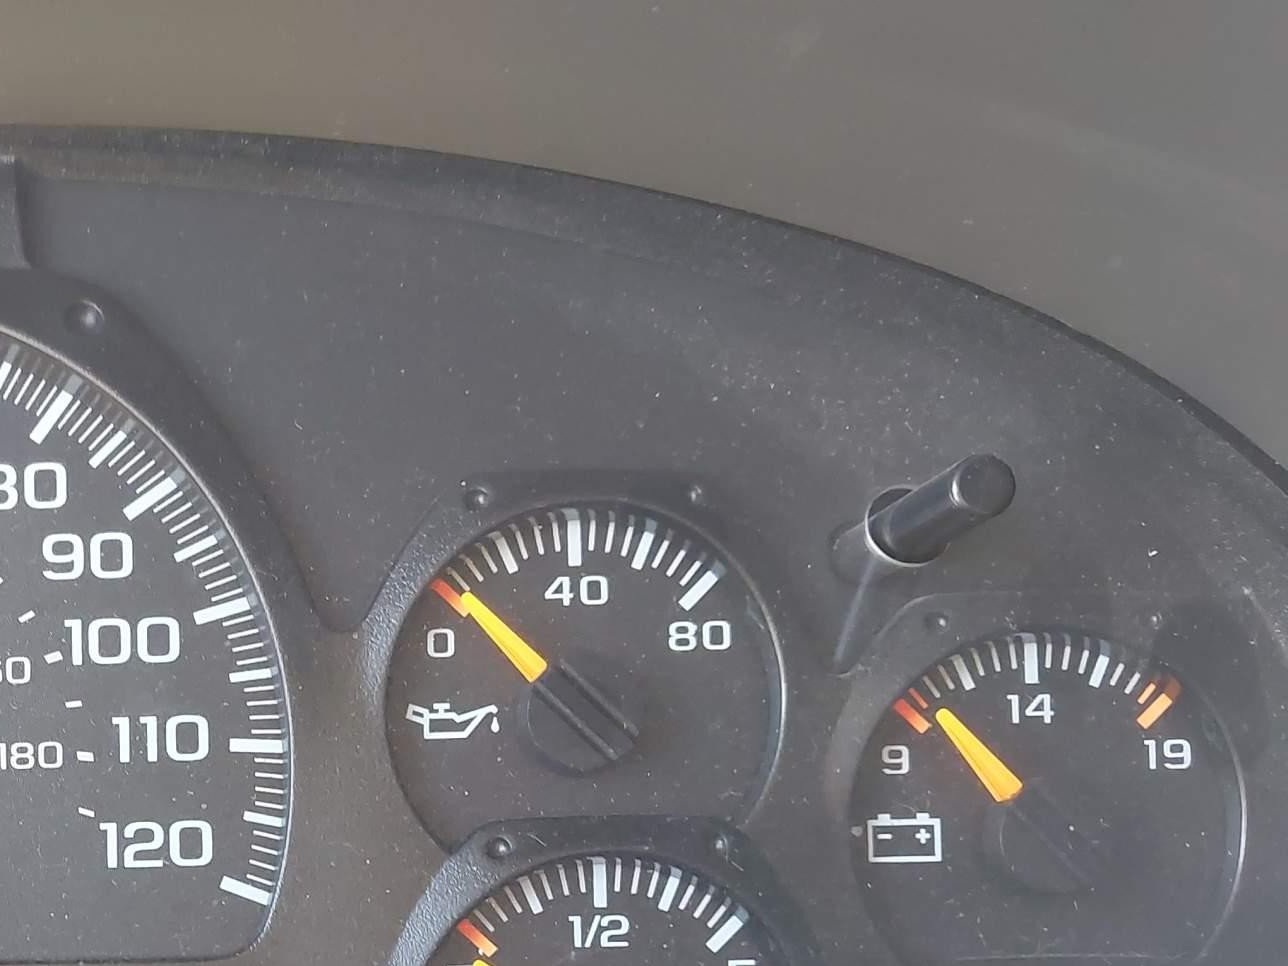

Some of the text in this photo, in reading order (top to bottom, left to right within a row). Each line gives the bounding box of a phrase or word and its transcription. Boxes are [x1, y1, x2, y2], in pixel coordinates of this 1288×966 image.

[43, 532, 133, 580] 90
[545, 576, 608, 606] 40
[64, 617, 180, 665] 100
[428, 629, 454, 657] 0
[669, 621, 730, 651] 80
[1007, 694, 1054, 723] 14
[112, 715, 208, 762] 110
[883, 746, 909, 774] 9
[1144, 739, 1191, 769] 19
[100, 820, 212, 868] 120
[569, 915, 629, 947] 1/2
